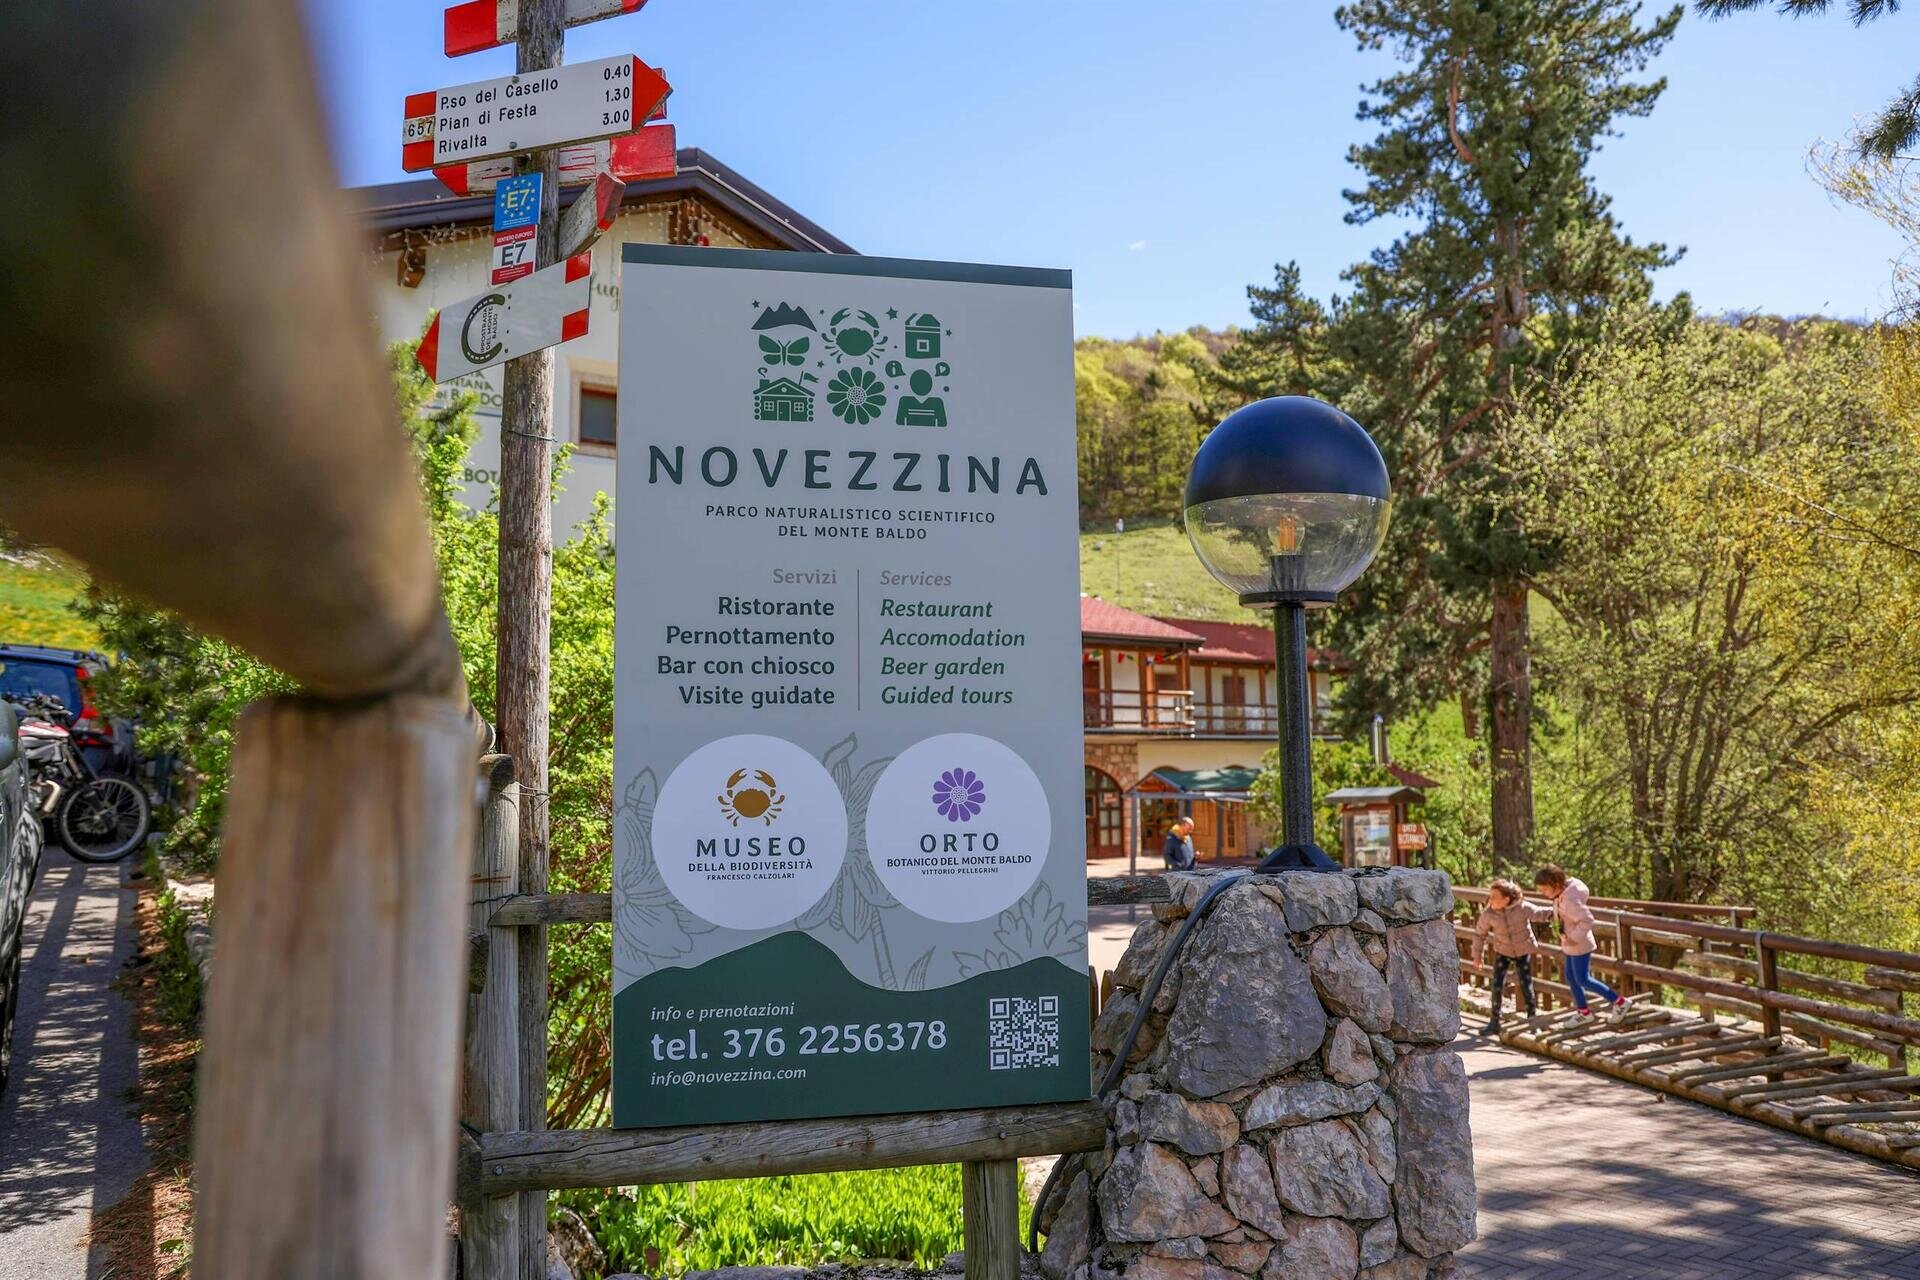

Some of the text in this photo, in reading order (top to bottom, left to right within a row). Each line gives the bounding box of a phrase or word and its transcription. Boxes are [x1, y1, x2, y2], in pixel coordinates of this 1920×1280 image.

[441, 64, 630, 110] P.so del Casello 0.40
[440, 86, 630, 132] Pian di Festa 1.30
[408, 120, 433, 137] 657
[439, 109, 629, 154] Rivalta 3.00
[507, 188, 530, 209] E7
[502, 242, 527, 267] E7
[648, 445, 1048, 496] NOVEZZINA
[705, 505, 995, 524] PARCO NATURALISTICO SCIENTIFICO
[778, 525, 927, 540] DEL MONTE BALDO
[772, 568, 837, 585] Servizi
[879, 570, 952, 587] Services
[718, 596, 835, 616] Ristorante
[879, 598, 993, 618] Restaurant
[666, 625, 835, 646] Pernottamento
[879, 627, 1025, 647] Accomodation
[657, 655, 835, 675] Bar con chiosco
[880, 656, 1005, 681] Beer garden
[678, 685, 835, 710] Visite guidate
[881, 686, 1013, 705] Guided tours
[696, 836, 806, 858] MUSEO
[919, 832, 999, 854] ORTO
[688, 858, 813, 872] DELLA BIODIVERSITÀ
[887, 854, 1032, 868] BOTANICO DEL MONTE BALDO
[753, 872, 795, 880] CALZOLARI
[650, 1001, 795, 1022] info e prenotazioni
[650, 1020, 947, 1061] tel. 376 2256378
[650, 1067, 807, 1087] info@novezzina.com
